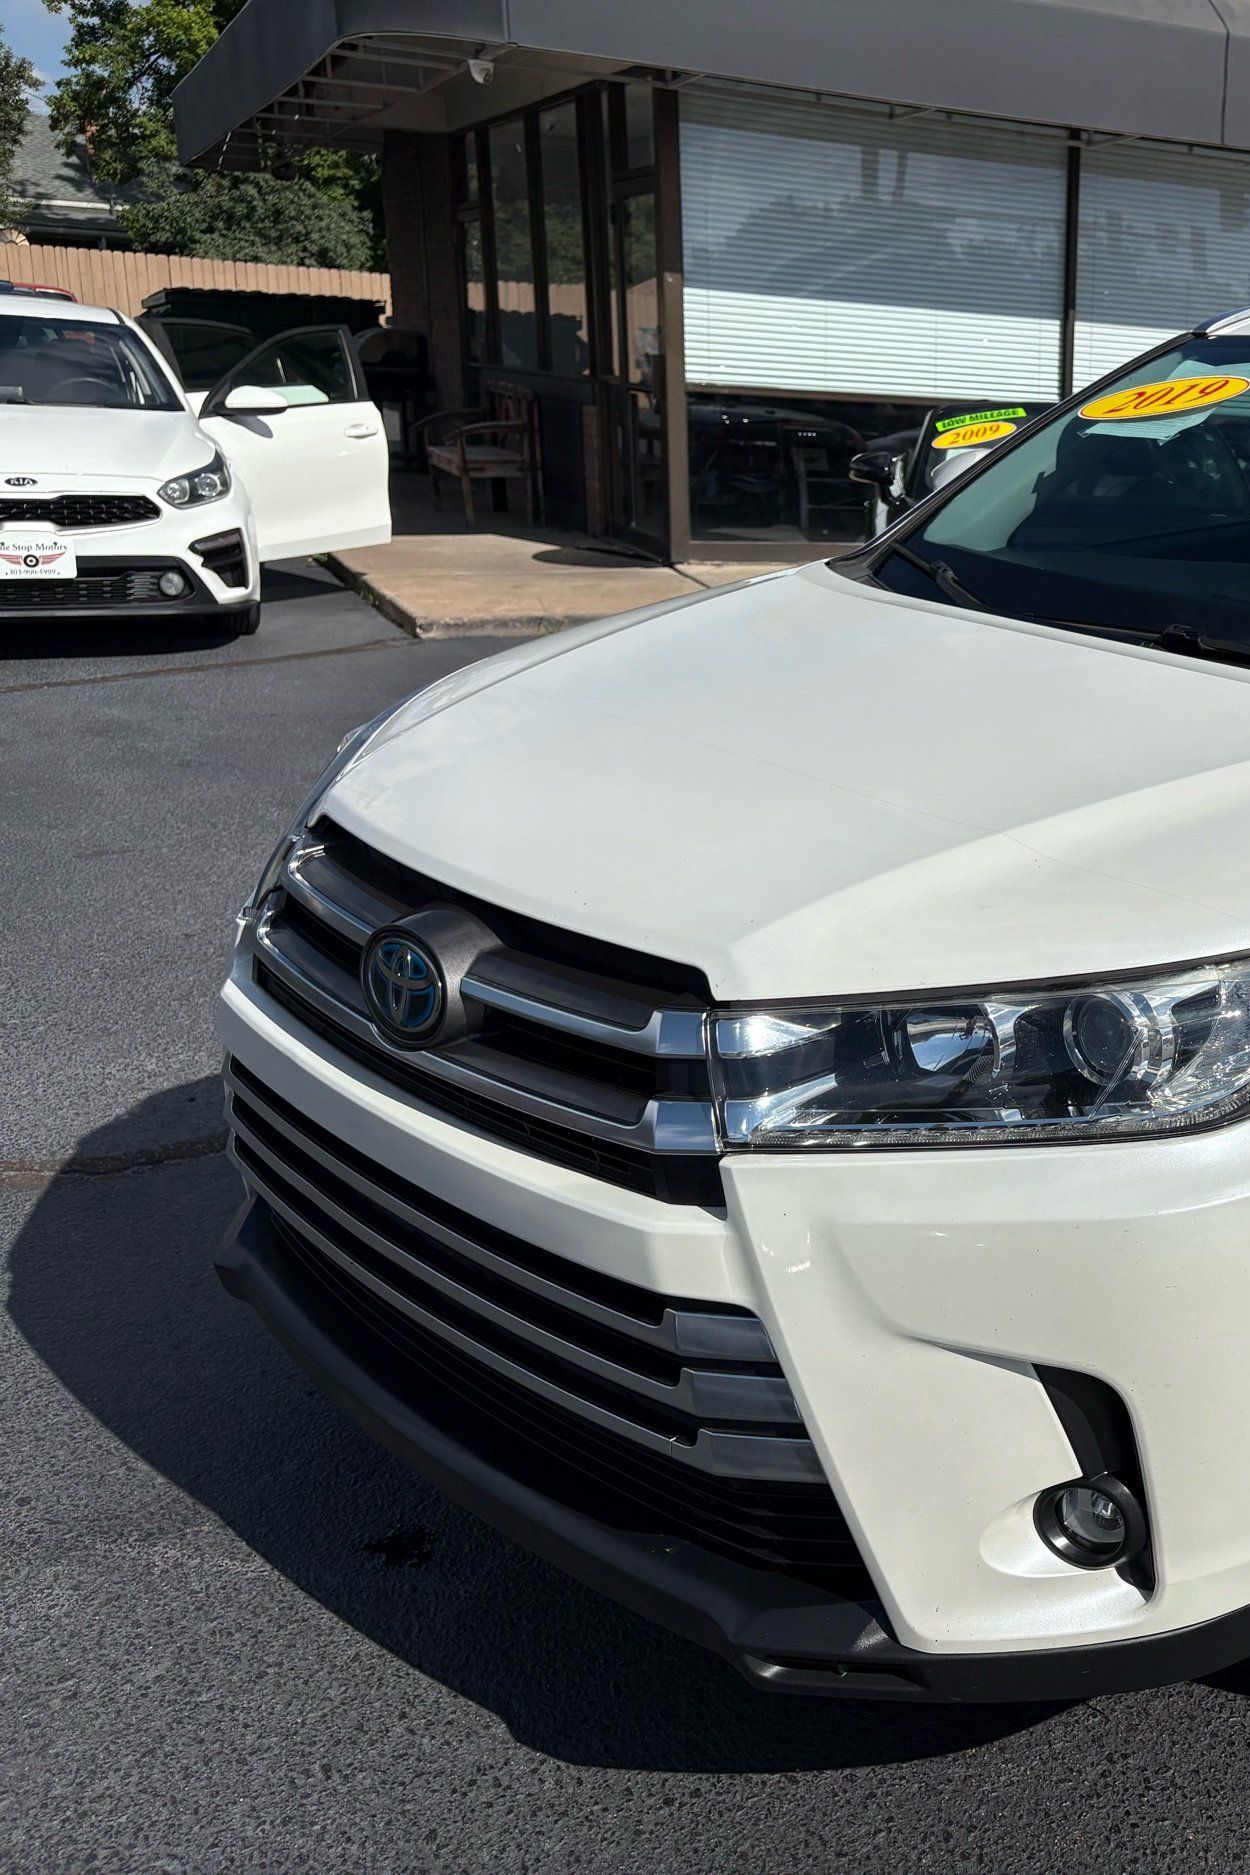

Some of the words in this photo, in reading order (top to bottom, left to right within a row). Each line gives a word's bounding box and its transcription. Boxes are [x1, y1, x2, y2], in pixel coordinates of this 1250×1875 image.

[1101, 379, 1231, 415] 2019
[942, 418, 967, 429] LOW
[969, 408, 1018, 422] MILEAGE
[948, 423, 1001, 446] 2009
[12, 543, 33, 552] Stop
[35, 542, 68, 551] Motors
